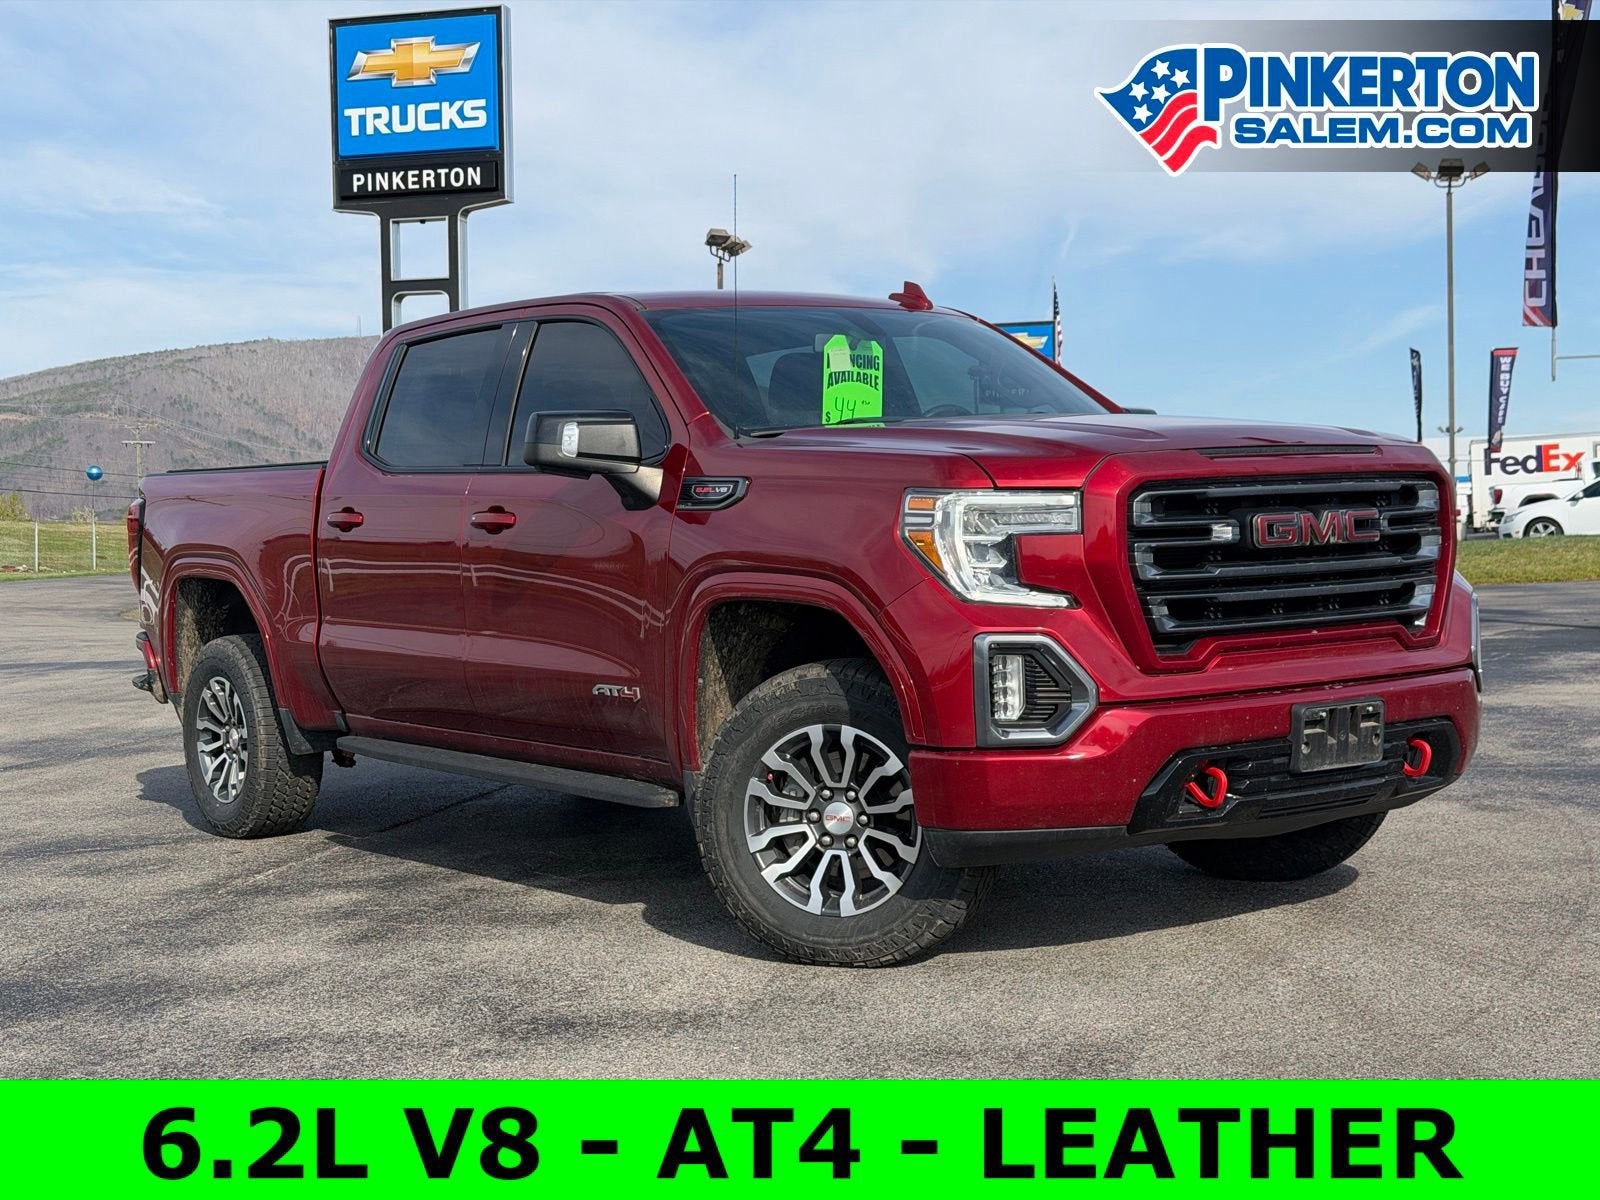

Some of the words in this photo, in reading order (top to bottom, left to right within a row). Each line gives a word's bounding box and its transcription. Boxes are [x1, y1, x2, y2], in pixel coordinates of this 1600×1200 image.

[344, 98, 487, 136] TRUCKS
[352, 166, 481, 192] PINKERTON
[827, 371, 880, 391] AVAILABLE
[1484, 443, 1585, 475] FedEx
[1255, 508, 1380, 549] GMC
[592, 684, 641, 703] AT4
[825, 814, 851, 823] GMC
